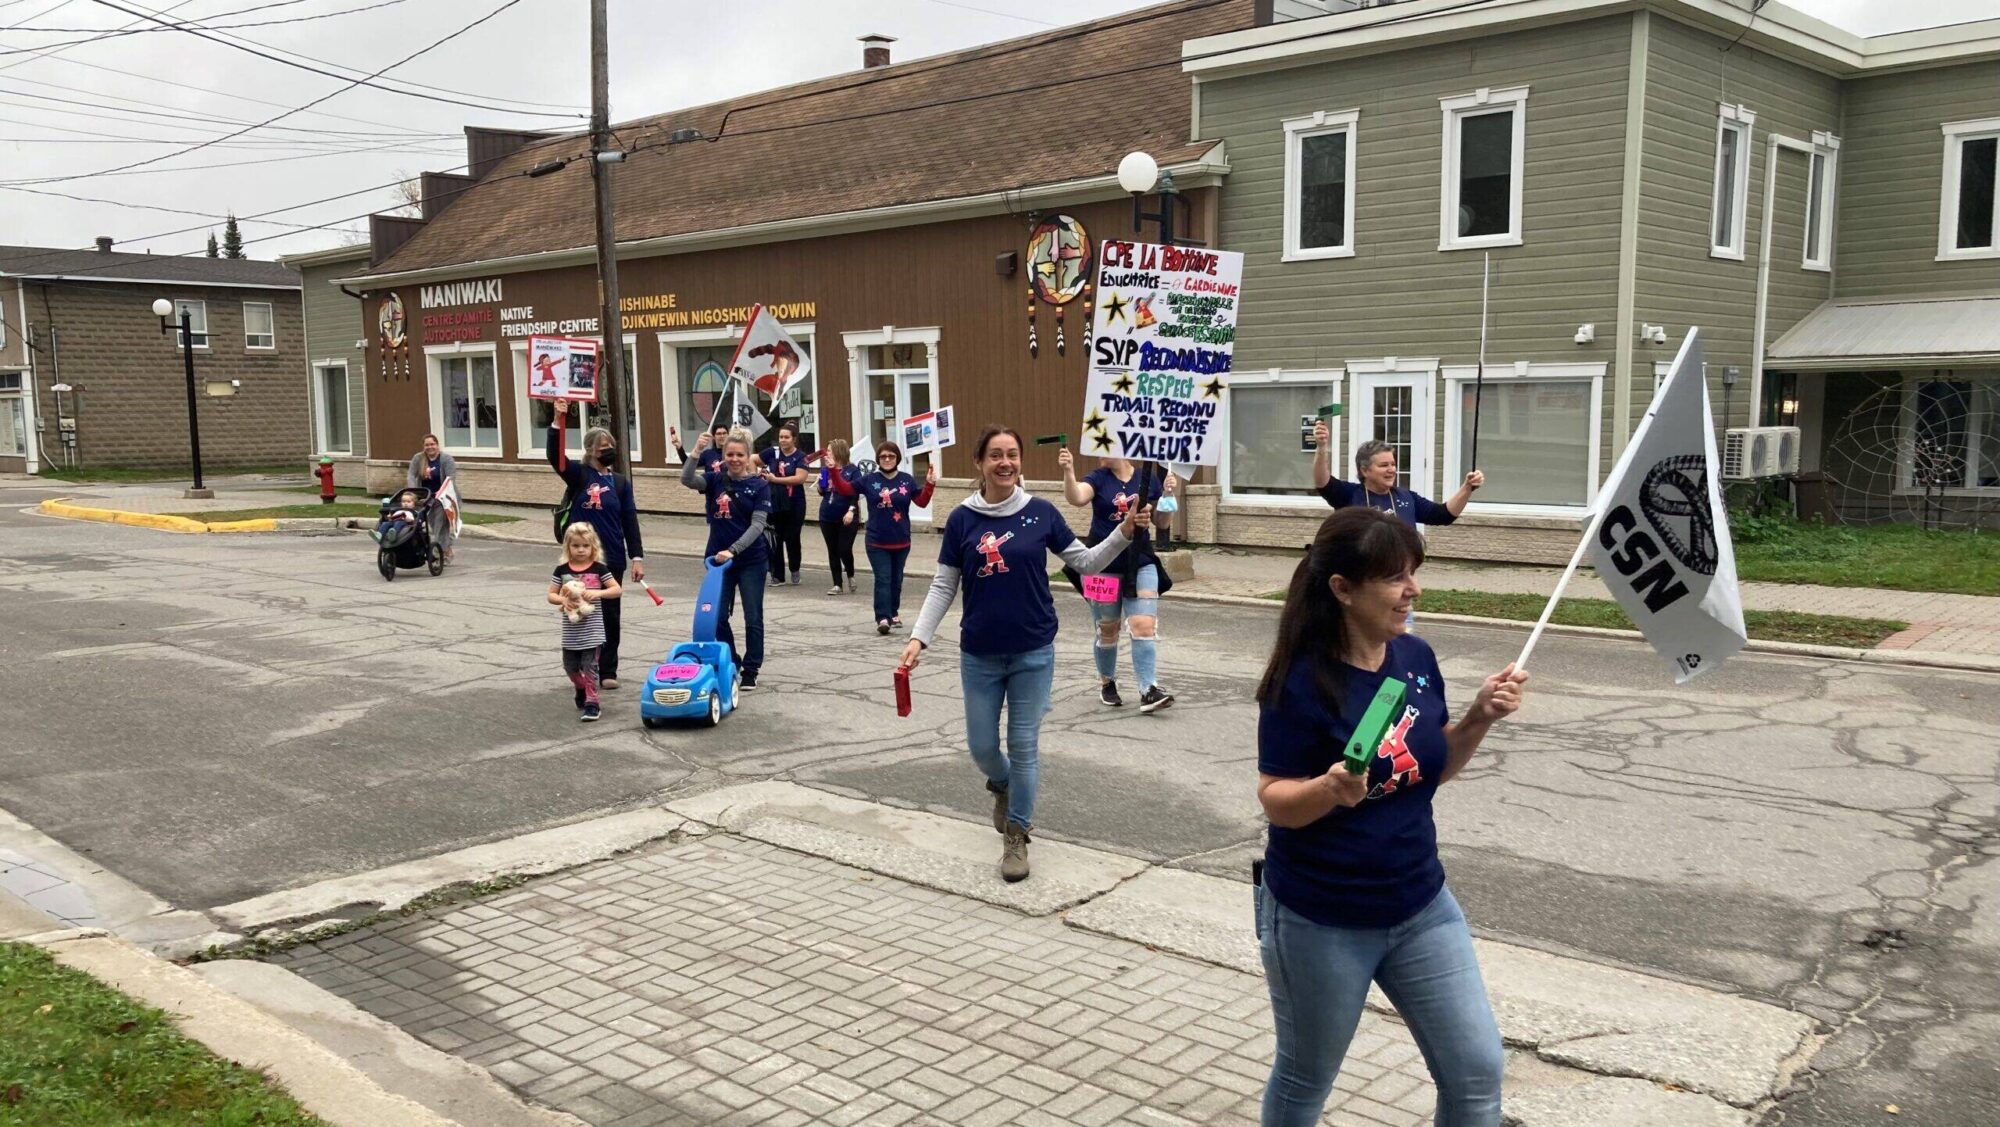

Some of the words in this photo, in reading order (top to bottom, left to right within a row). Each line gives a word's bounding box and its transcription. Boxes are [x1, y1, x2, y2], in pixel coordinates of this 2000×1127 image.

[1102, 241, 1135, 269] CPE
[1138, 244, 1157, 270] LA
[420, 278, 502, 309] MANIWAKI
[619, 294, 677, 311] ISHINABE
[422, 312, 454, 328] CENTRE
[500, 306, 534, 321] NATIVE
[621, 311, 689, 329] DJIKIWEWIN
[692, 301, 817, 326] NIGOSHKIDOWIN
[423, 327, 481, 343] AUTOCHTONE
[501, 321, 558, 337] FRIENDSHIP
[559, 318, 599, 333] CENTRE
[1101, 393, 1155, 415] TRAVAIL
[1157, 397, 1216, 419] RECONNU
[1138, 415, 1155, 429] SA
[1159, 416, 1209, 435] JUSTE
[1599, 504, 1690, 615] CSN
[1092, 577, 1106, 585] EN
